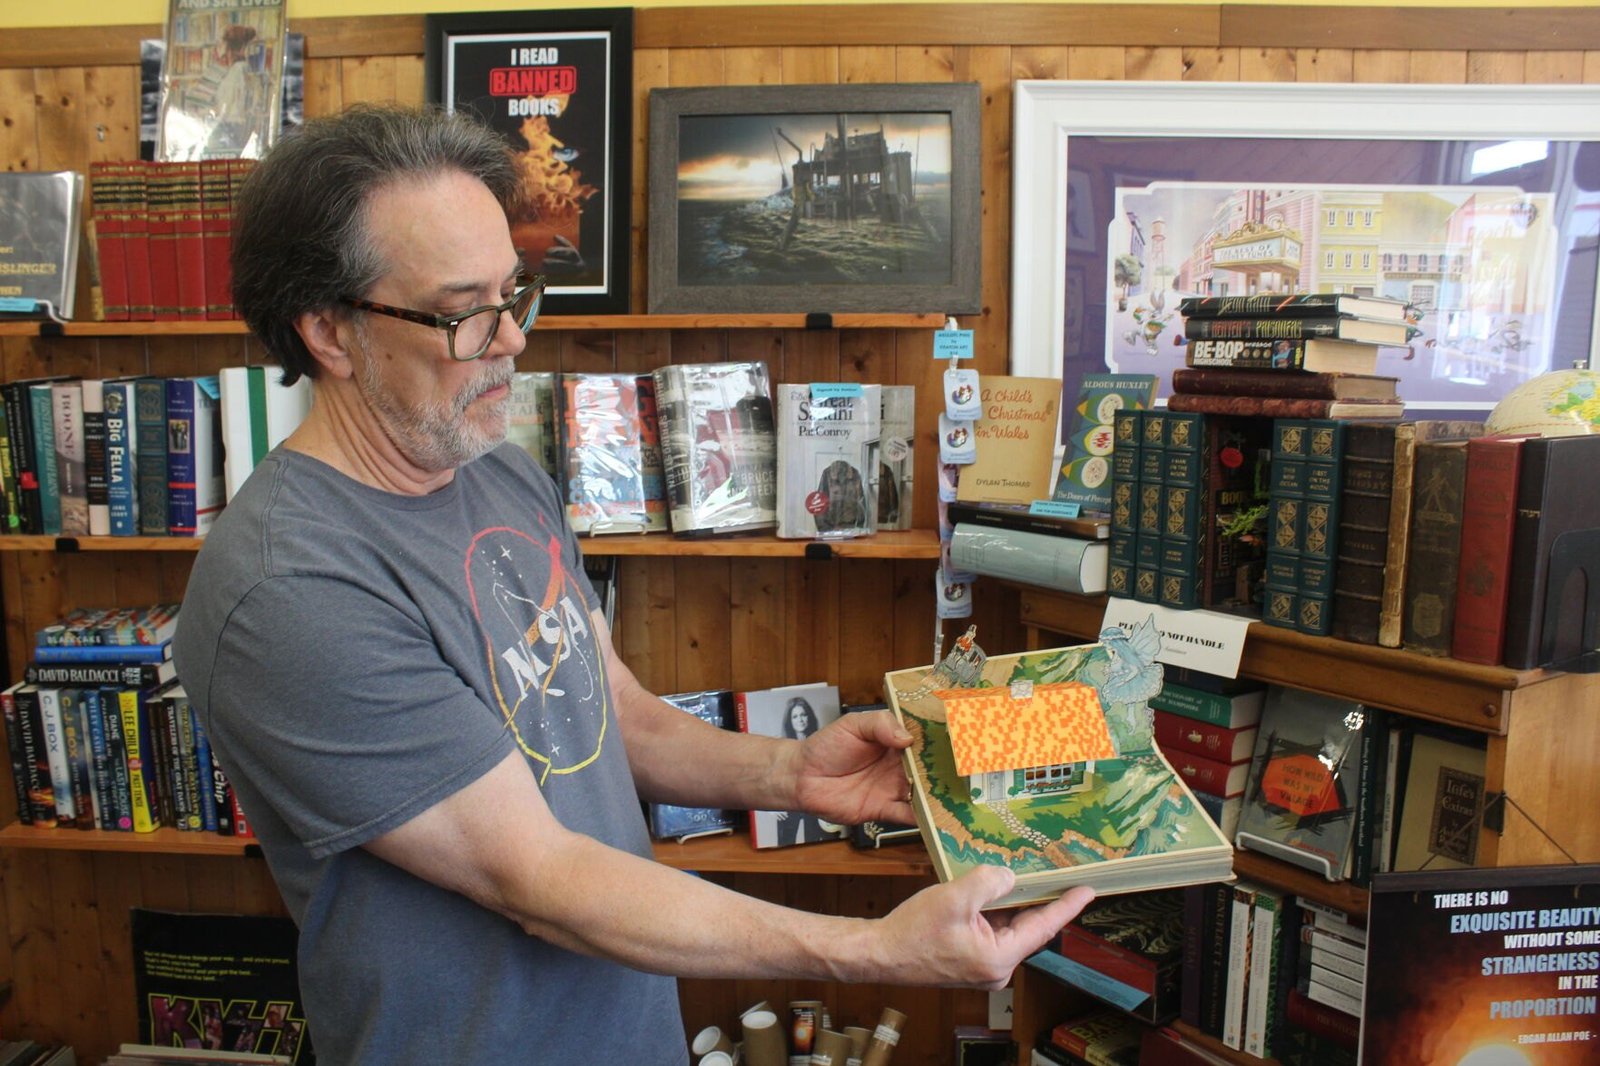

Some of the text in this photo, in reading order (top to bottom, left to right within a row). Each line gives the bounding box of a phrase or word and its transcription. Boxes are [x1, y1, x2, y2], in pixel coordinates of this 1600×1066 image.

[511, 47, 558, 65] I READ
[492, 69, 573, 93] BANNED
[508, 98, 560, 116] BOOKS
[1194, 340, 1244, 359] BE-BOP
[1083, 380, 1151, 390] ALDOUS HUXLEY
[981, 388, 1033, 403] A Child's
[798, 401, 853, 421] Stini
[988, 404, 1050, 422] Christmas
[61, 393, 75, 455] BOONE
[107, 418, 123, 442] BIG
[816, 426, 851, 440] Conroy
[976, 425, 1030, 440] in Wales
[109, 446, 125, 483] FELLA
[1091, 493, 1112, 504] Percep
[1167, 632, 1185, 641] NOT
[1186, 635, 1225, 650] HANDLE
[39, 668, 69, 682] DAVID
[70, 668, 119, 682] BALDACCI
[89, 696, 98, 725] WILEY
[19, 710, 34, 743] DAVID
[109, 714, 120, 740] DIANE
[167, 705, 178, 745] TRAVELERS
[48, 723, 58, 753] BOX
[65, 727, 78, 758] BOX
[92, 728, 100, 753] CASH
[124, 711, 144, 808] LEE CHILD PAST TENSE
[115, 767, 129, 816] LAST HOUSE
[175, 772, 183, 791] GRAY
[214, 770, 226, 804] Chip
[176, 792, 185, 813] DAWN
[1442, 795, 1472, 815] Extras
[1434, 890, 1509, 909] THERE IS NO
[1450, 907, 1600, 934] EXQUISITE BEAUTY
[1504, 930, 1600, 949] WITHOUT SOME
[1481, 952, 1600, 976] STRANGENESS
[1558, 975, 1599, 990] IN THE
[1489, 996, 1597, 1020] PROPORTION
[1518, 1031, 1591, 1044] EDGAR ALLAN POE
